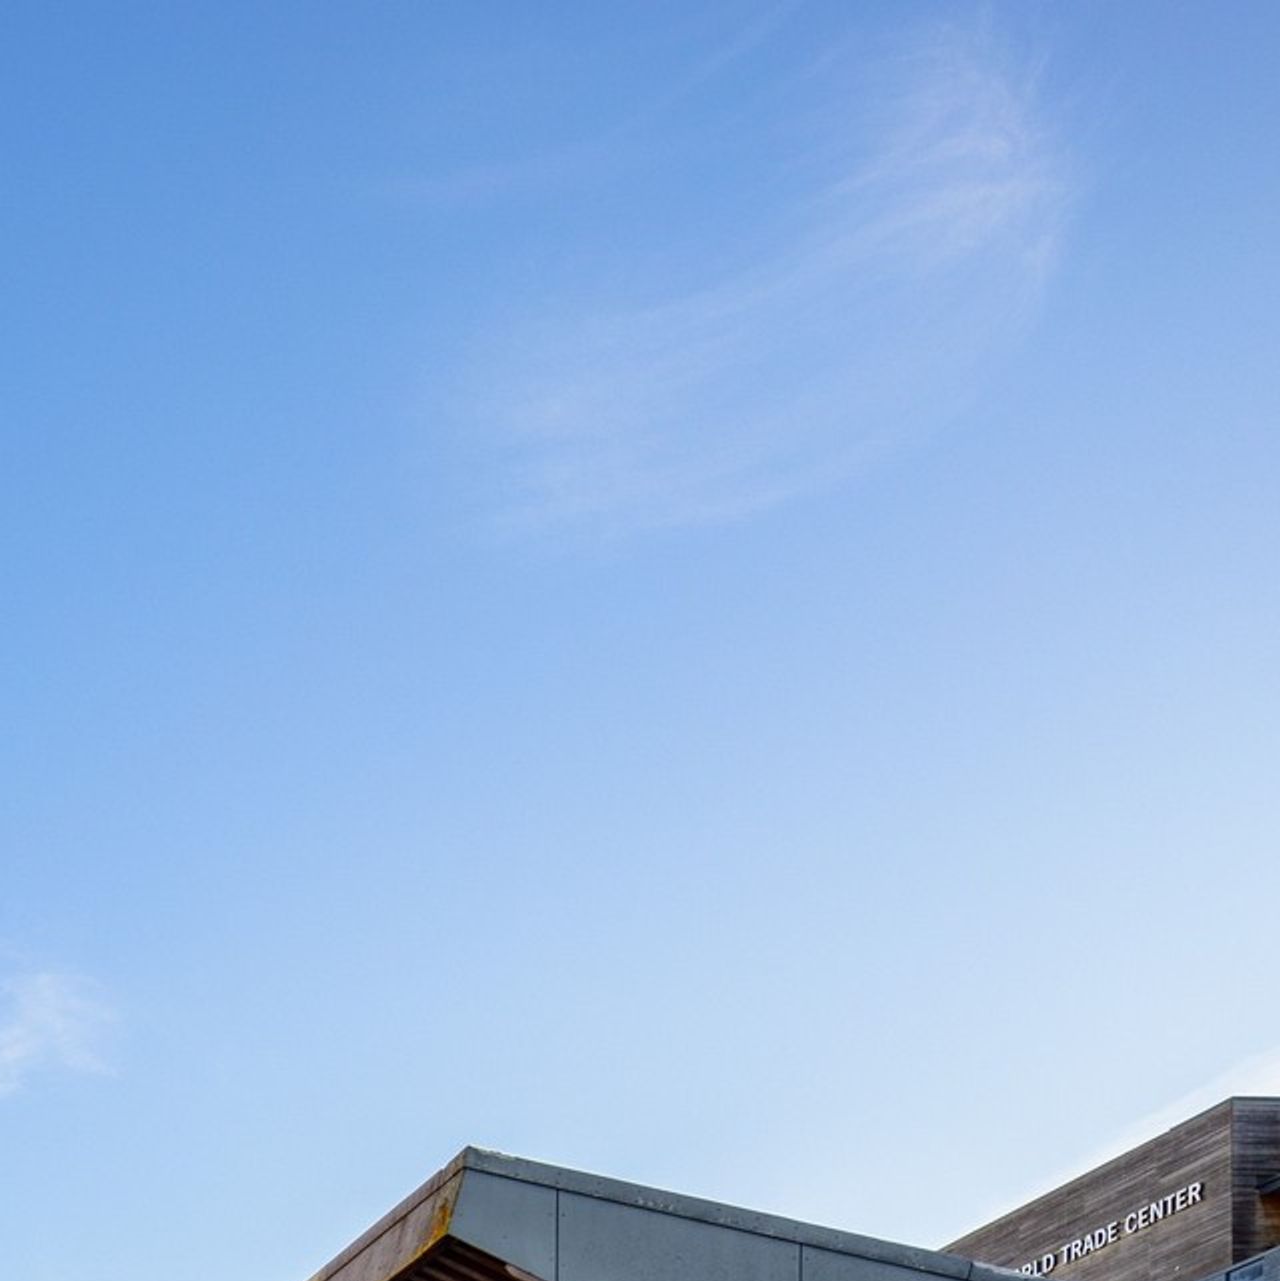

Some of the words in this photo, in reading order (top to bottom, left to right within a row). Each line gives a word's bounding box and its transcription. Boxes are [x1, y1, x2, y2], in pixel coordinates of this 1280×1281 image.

[1015, 1254, 1056, 1277] RLD
[1060, 1222, 1120, 1263] TRADE
[1124, 1182, 1204, 1234] CENTER
